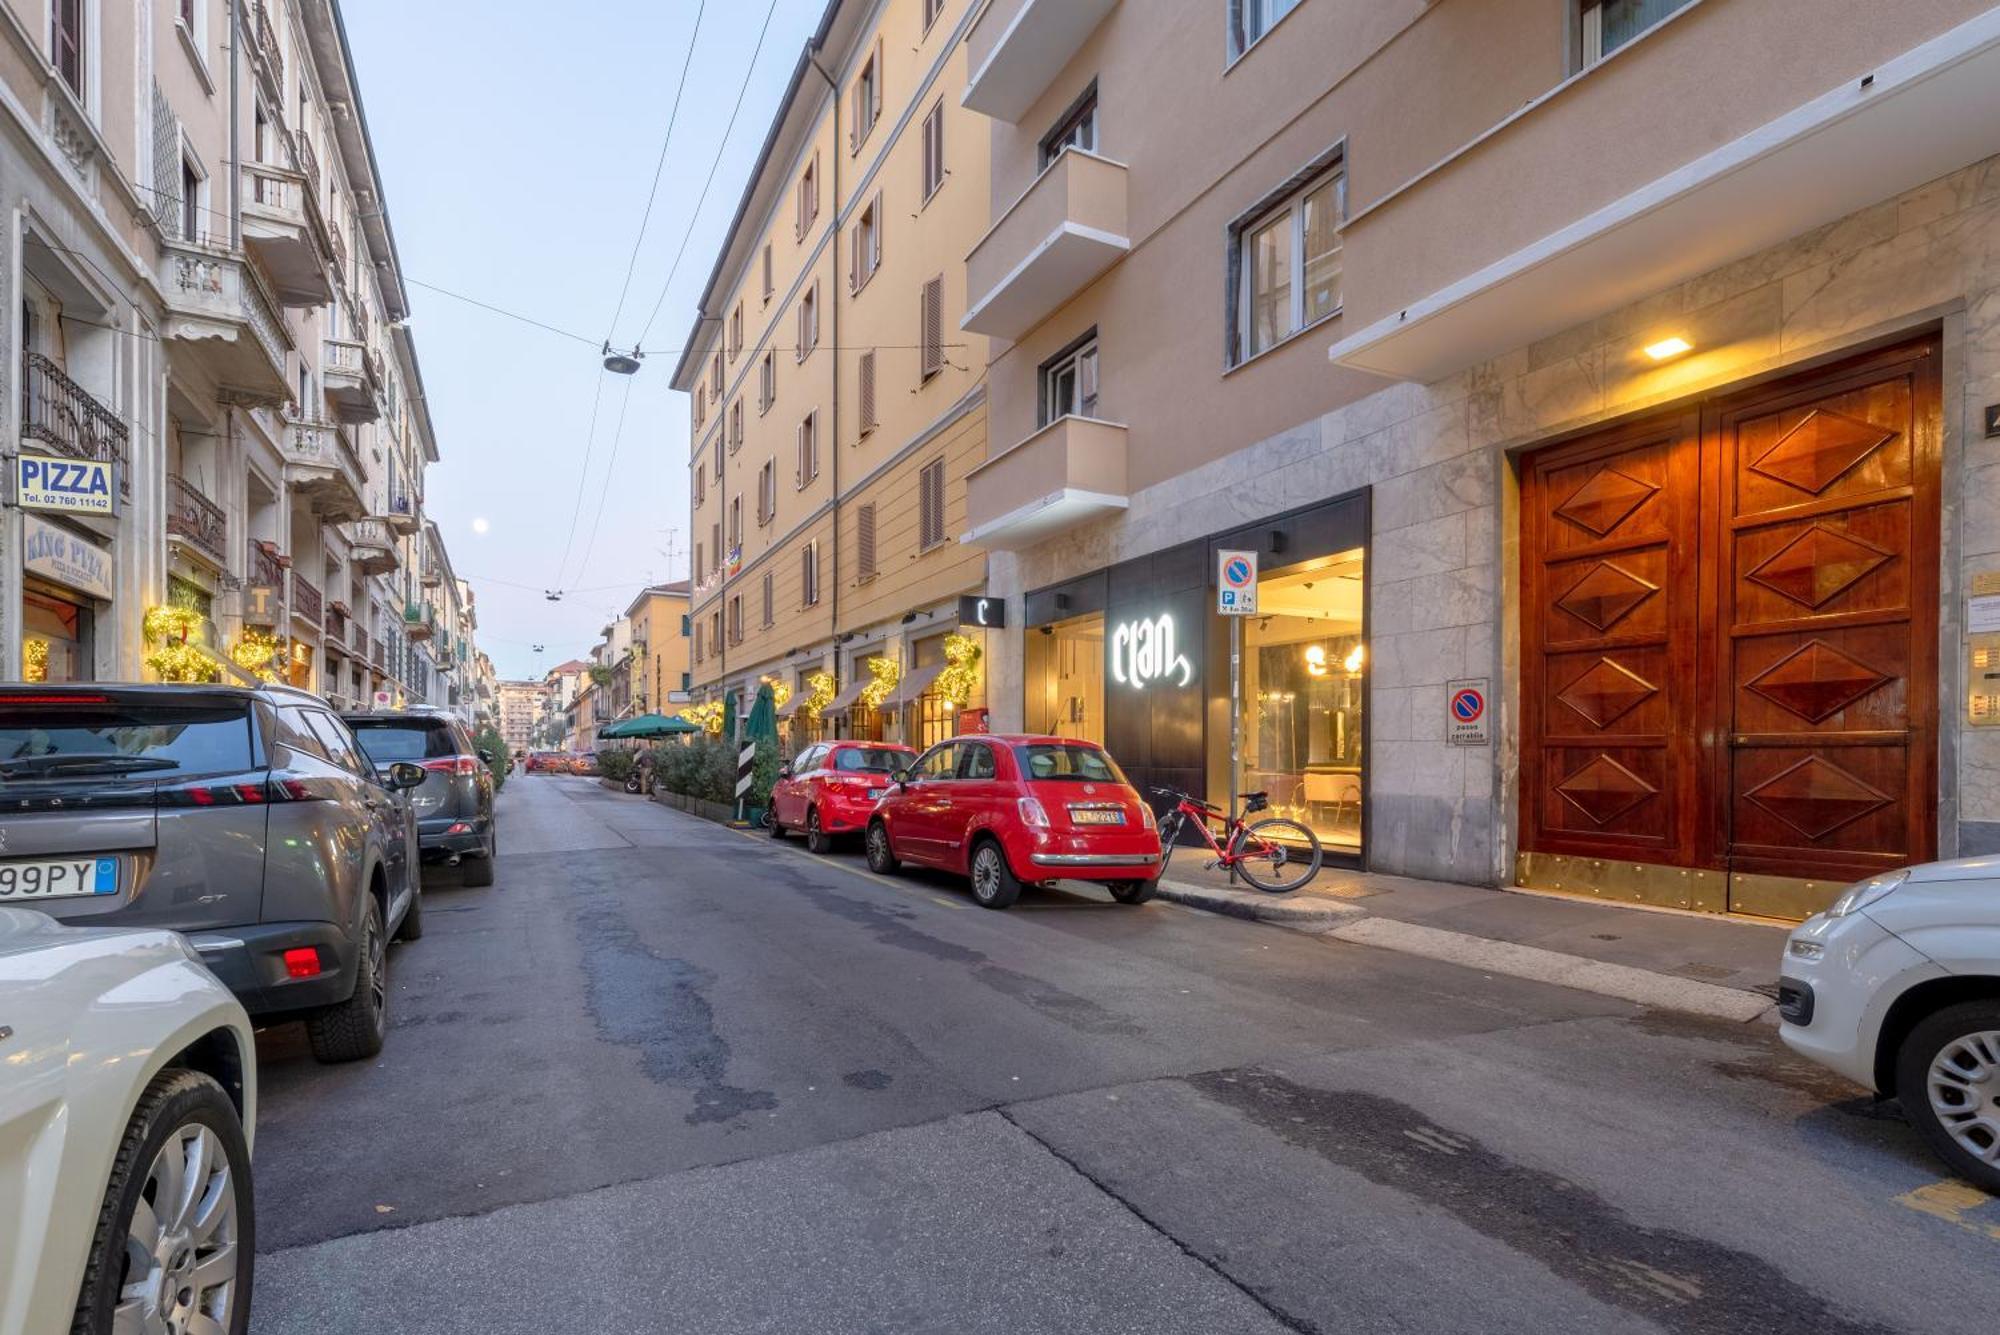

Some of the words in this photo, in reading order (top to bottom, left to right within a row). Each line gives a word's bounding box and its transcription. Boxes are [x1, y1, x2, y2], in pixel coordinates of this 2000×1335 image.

[21, 460, 109, 495] PIZZA
[23, 493, 41, 503] Tel.
[43, 494, 56, 504] 02
[59, 495, 76, 505] 760
[80, 498, 108, 508] 11142
[0, 863, 91, 896] 99PY
